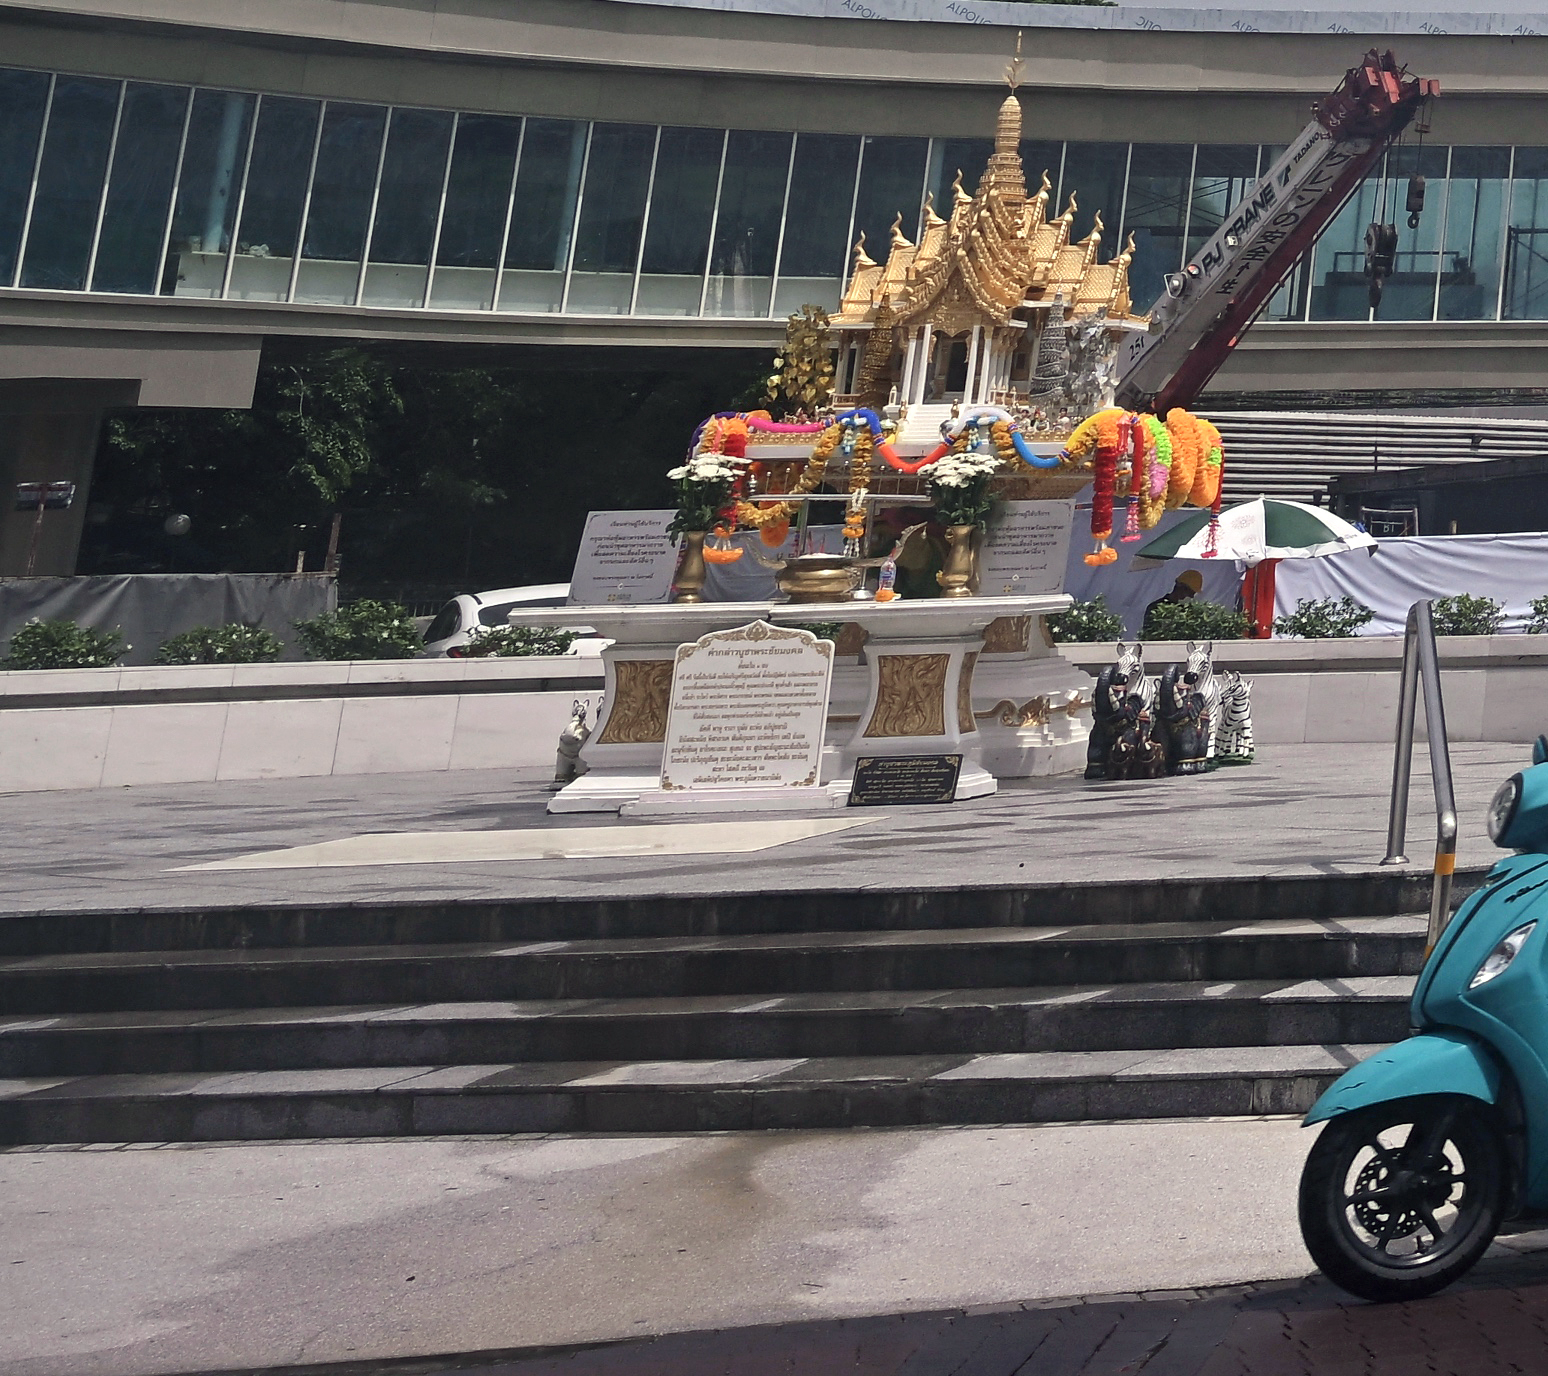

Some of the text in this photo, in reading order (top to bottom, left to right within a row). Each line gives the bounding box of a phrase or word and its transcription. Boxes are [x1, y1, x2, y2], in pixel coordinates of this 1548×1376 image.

[1293, 131, 1320, 164] TADANO
[1201, 181, 1276, 275] PJ CRANE
